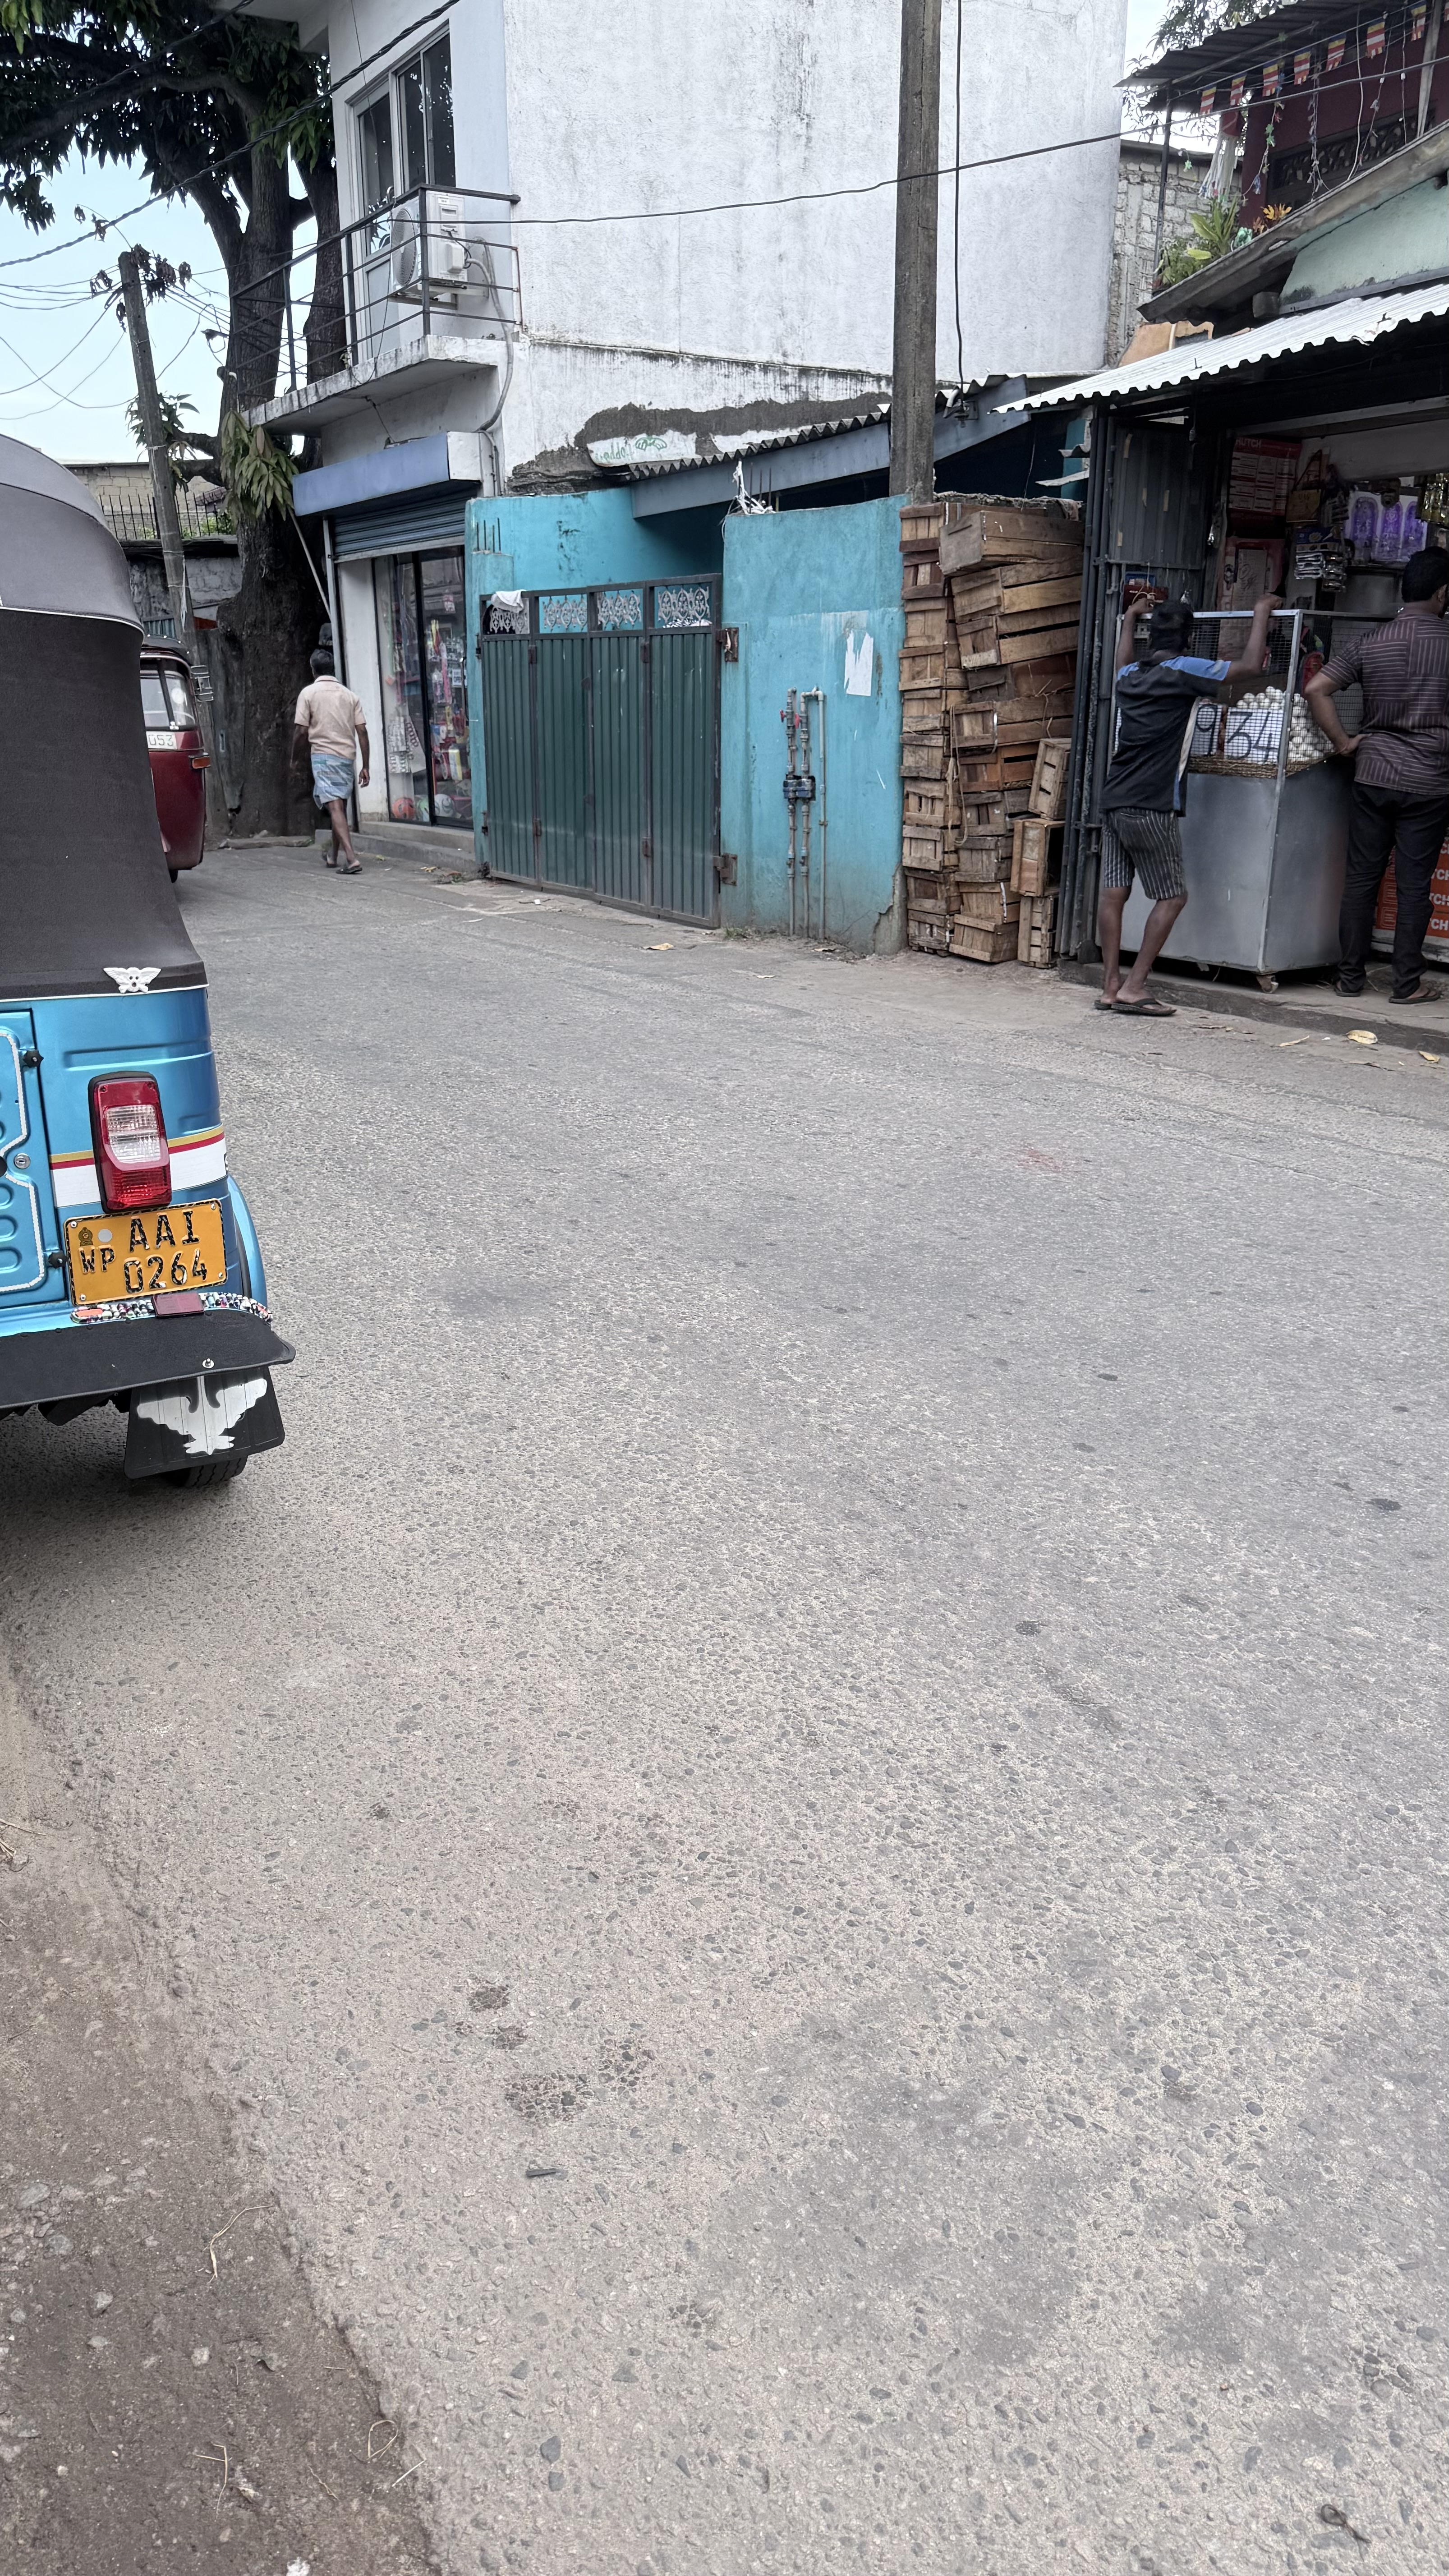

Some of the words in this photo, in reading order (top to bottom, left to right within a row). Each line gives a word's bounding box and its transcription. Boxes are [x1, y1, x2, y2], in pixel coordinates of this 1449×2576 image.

[129, 1209, 200, 1252] AAI
[79, 1245, 115, 1274] WP
[124, 1248, 207, 1294] 0264
